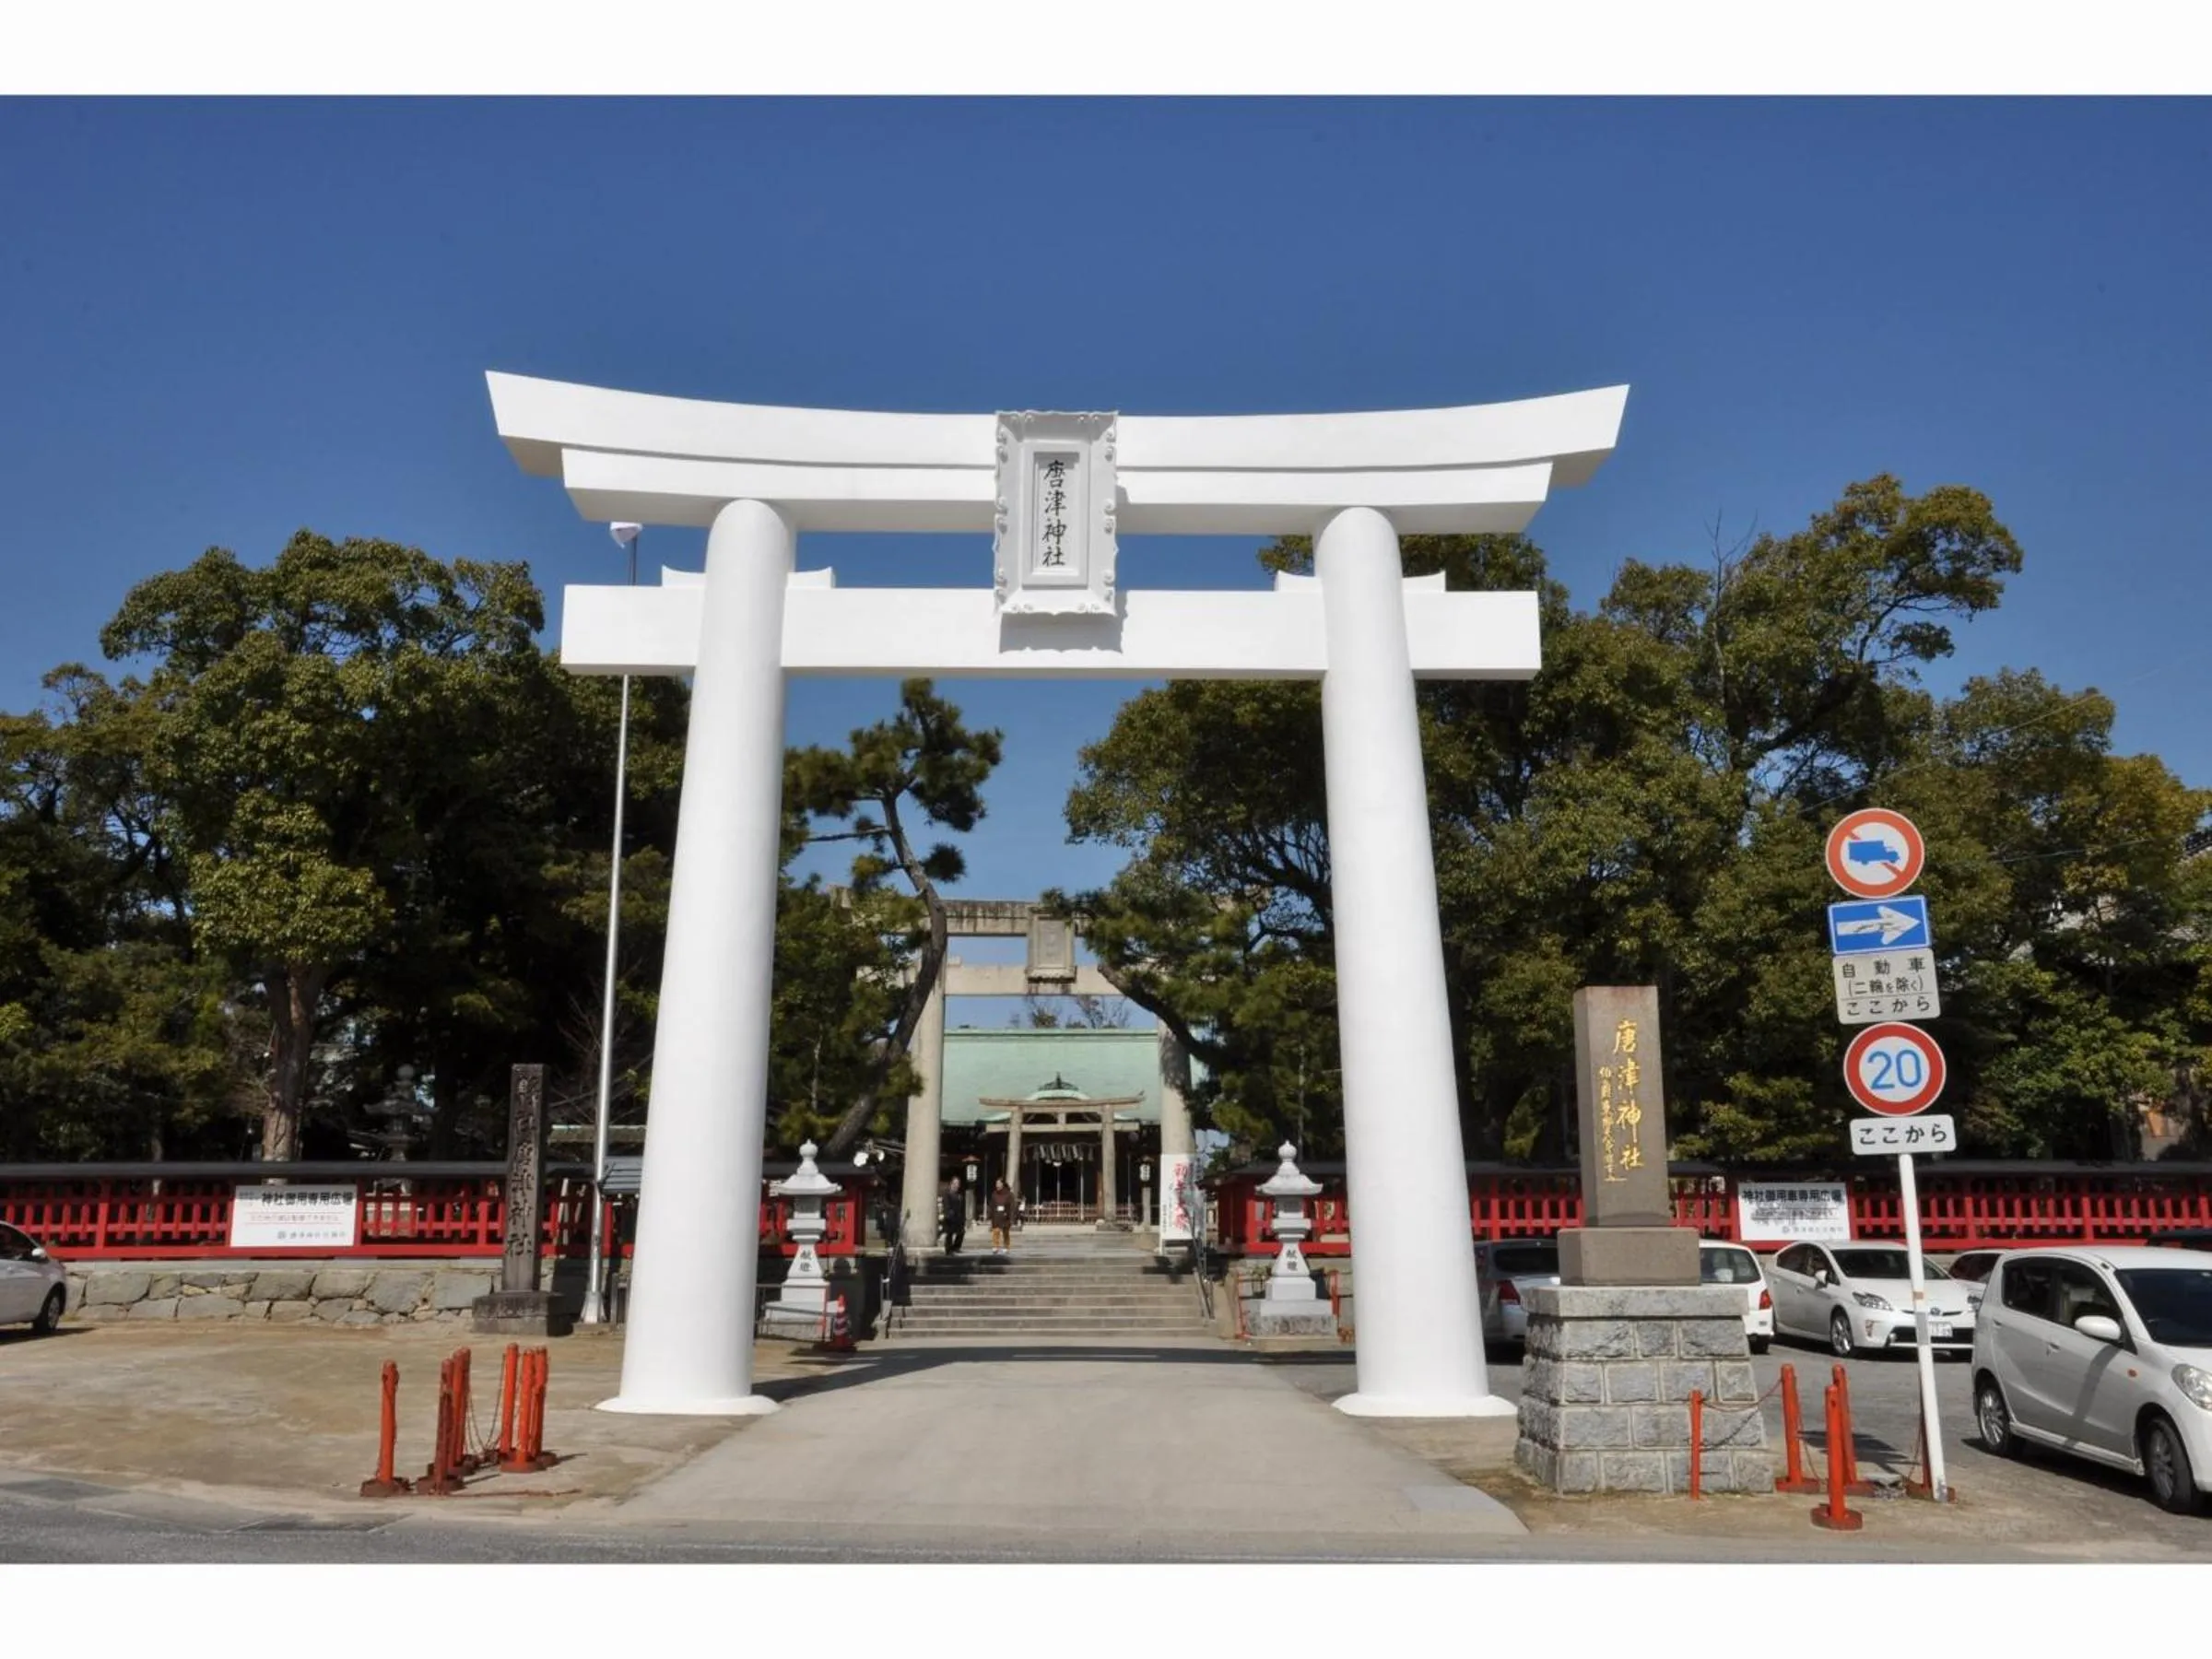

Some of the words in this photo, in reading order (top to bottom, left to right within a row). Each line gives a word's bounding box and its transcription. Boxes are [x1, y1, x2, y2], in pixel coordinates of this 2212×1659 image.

[1042, 459, 1066, 567] 唐津神社
[1841, 957, 1925, 979] 自動車
[1846, 996, 1930, 1016] ここから
[1867, 1049, 1923, 1089] 20
[1613, 1019, 1644, 1171] 唐津神社
[1859, 1123, 1947, 1145] ここから
